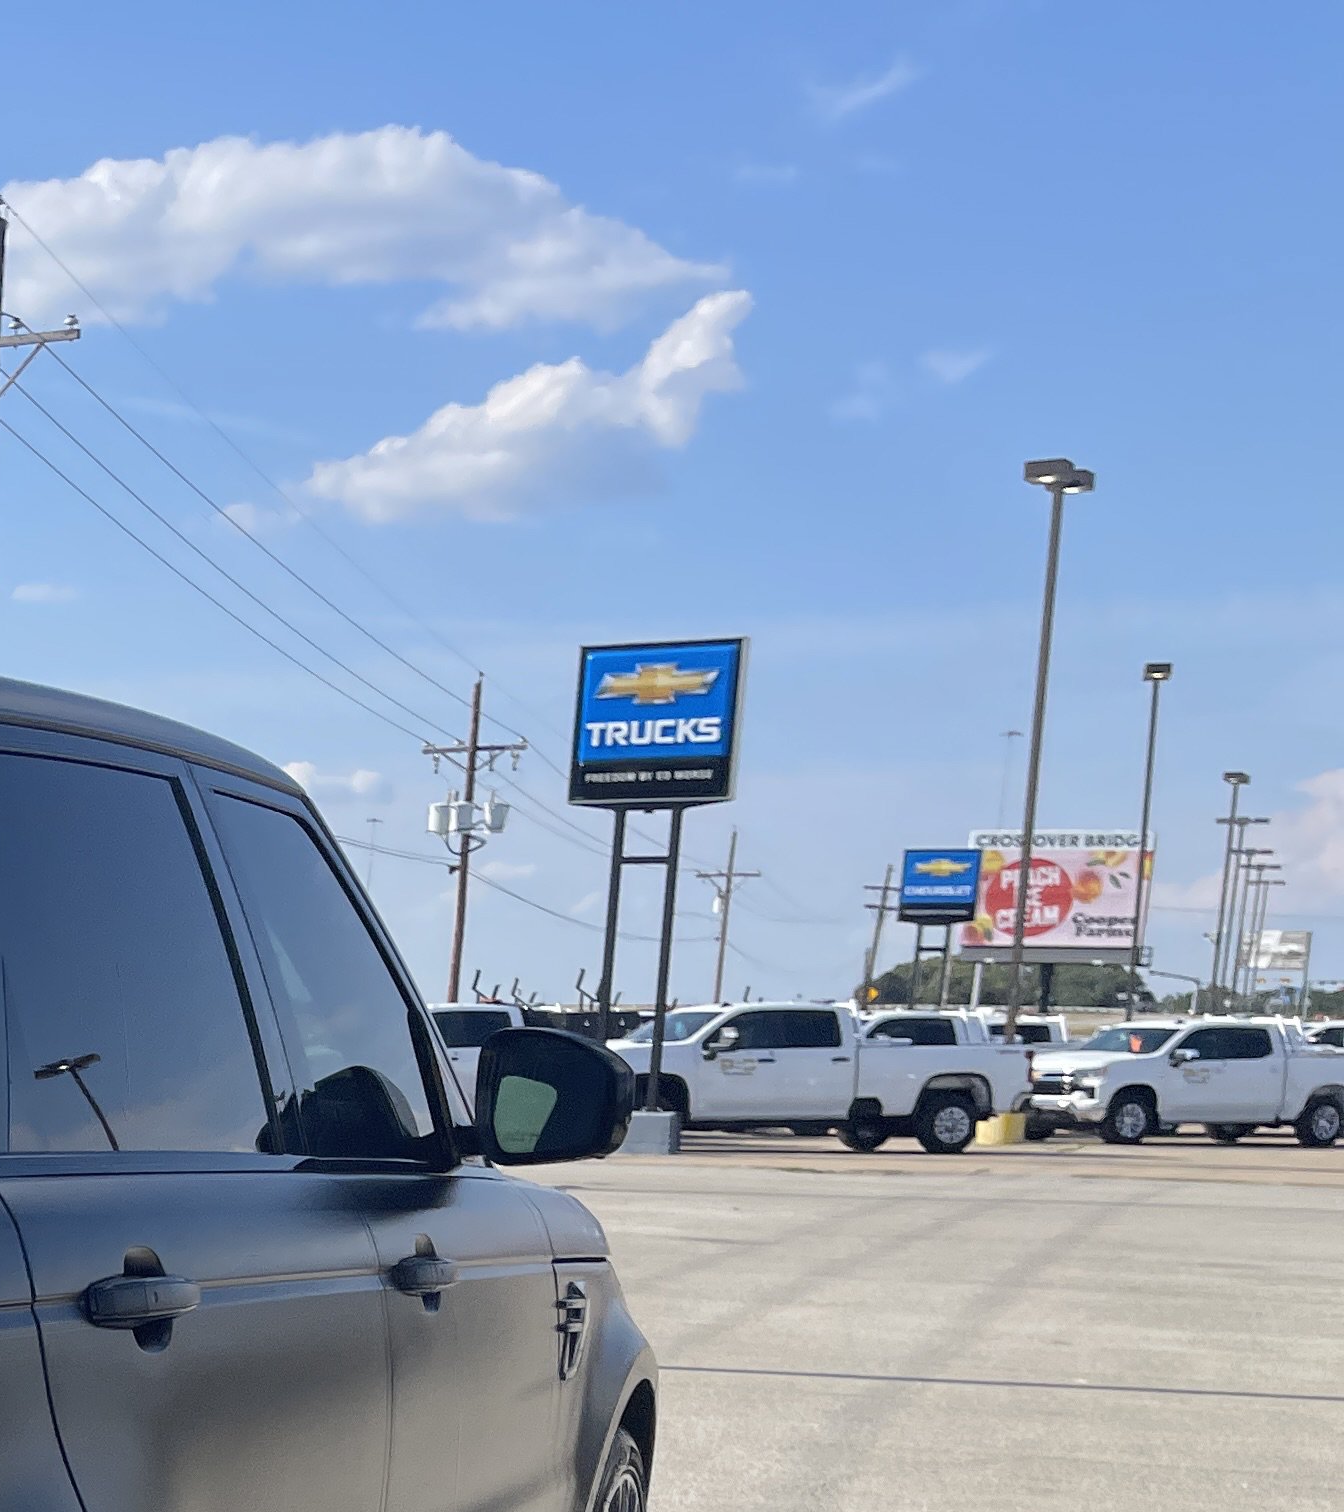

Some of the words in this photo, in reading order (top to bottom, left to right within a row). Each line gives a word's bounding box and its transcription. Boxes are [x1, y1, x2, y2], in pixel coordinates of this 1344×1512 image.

[585, 717, 721, 747] TRUCKS
[976, 834, 1079, 848] CROSOVER
[1085, 834, 1141, 848] BRIDG
